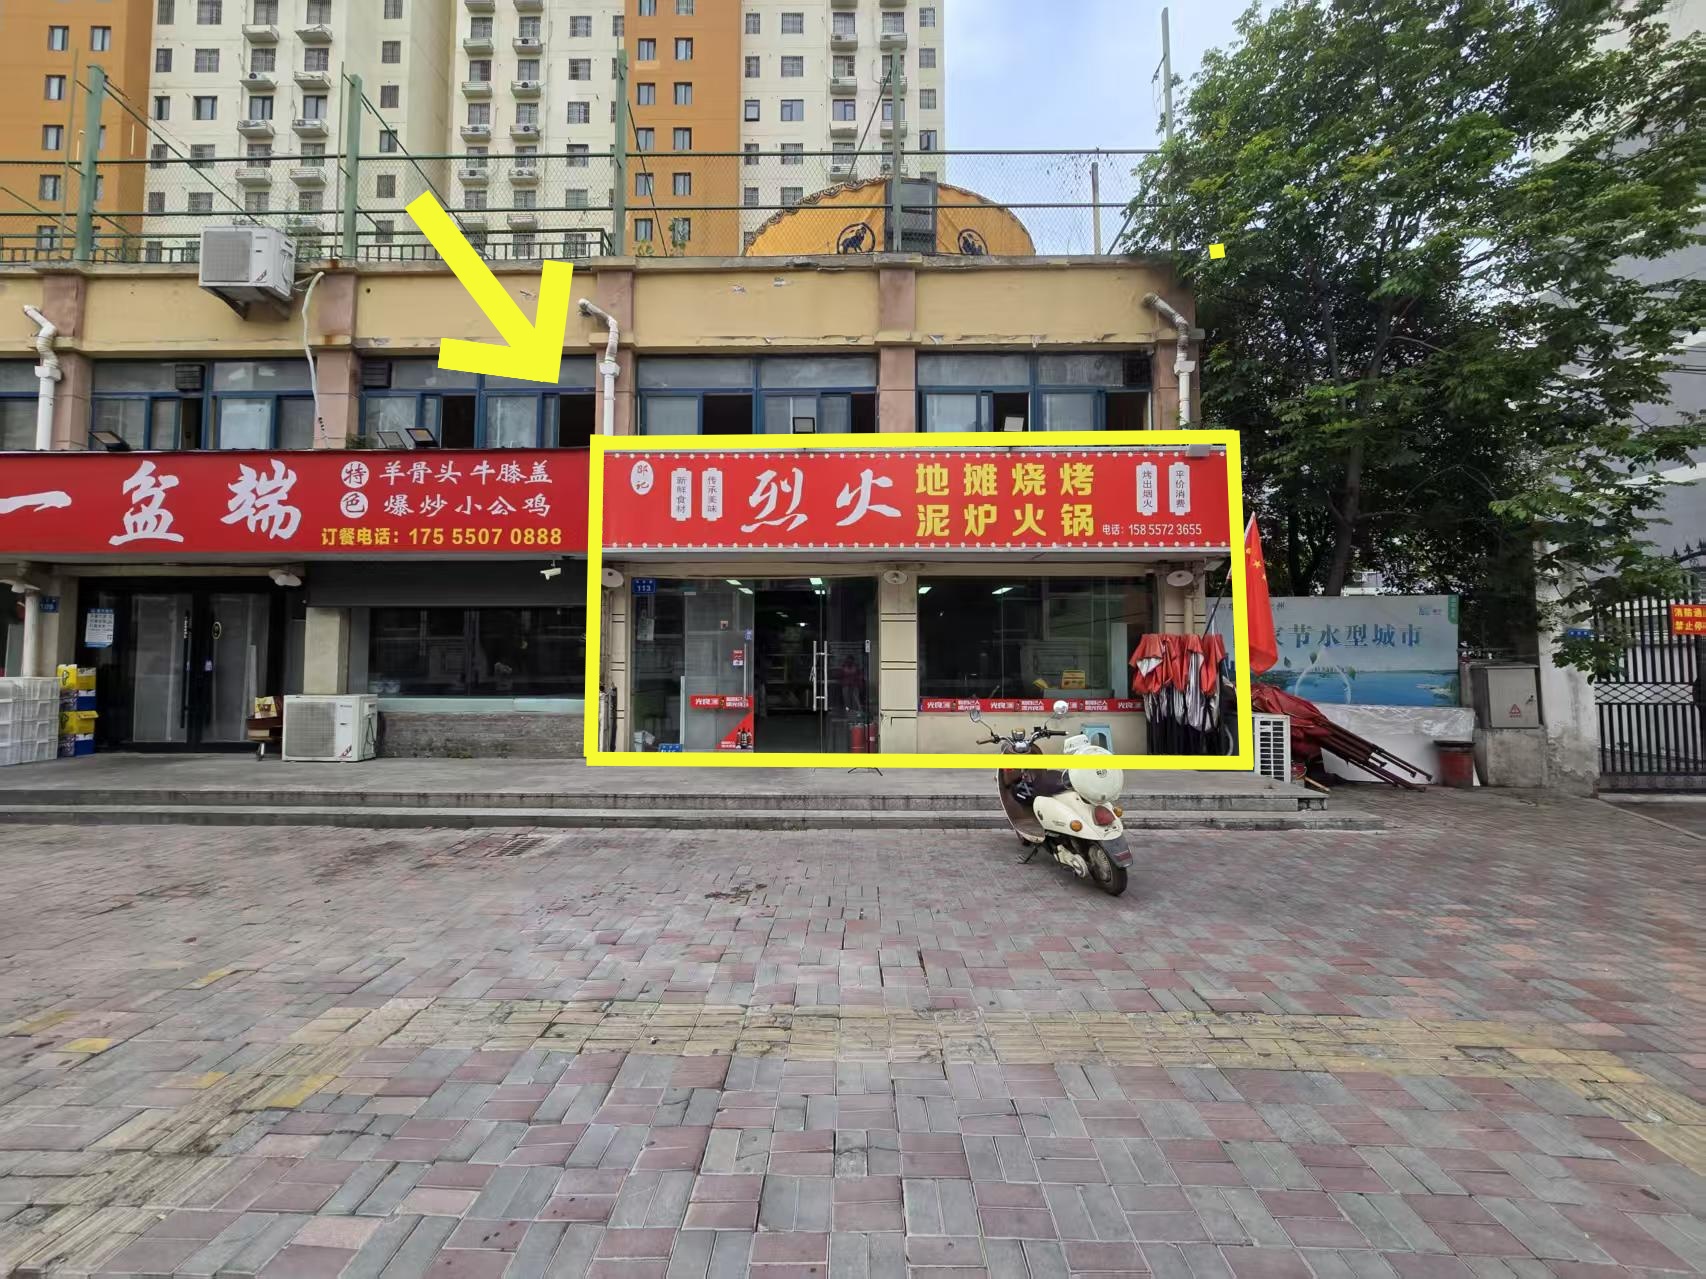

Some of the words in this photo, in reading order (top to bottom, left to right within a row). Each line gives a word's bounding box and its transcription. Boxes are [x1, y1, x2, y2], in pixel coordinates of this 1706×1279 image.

[342, 463, 368, 514] 特色
[379, 460, 462, 485] 羊骨头
[469, 460, 553, 485] 牛膝盖
[915, 463, 1094, 497] 地摊烧烤
[1142, 470, 1153, 508] 烤出烟火
[1175, 470, 1186, 508] 平价消费
[0, 459, 301, 546] 一盆端
[384, 493, 550, 517] 爆炒小公鸡
[676, 476, 687, 514] 新鲜食材
[707, 476, 718, 513] 传承美味
[740, 467, 901, 533] 烈火
[409, 528, 444, 545] 175
[452, 528, 503, 545] 5507
[511, 528, 562, 545] 0888
[915, 503, 1094, 537] 泥炉火锅
[1128, 524, 1147, 536] 158
[1148, 524, 1174, 536] 5572
[1176, 524, 1202, 536] 3655
[1674, 620, 1706, 631] 禁止停
